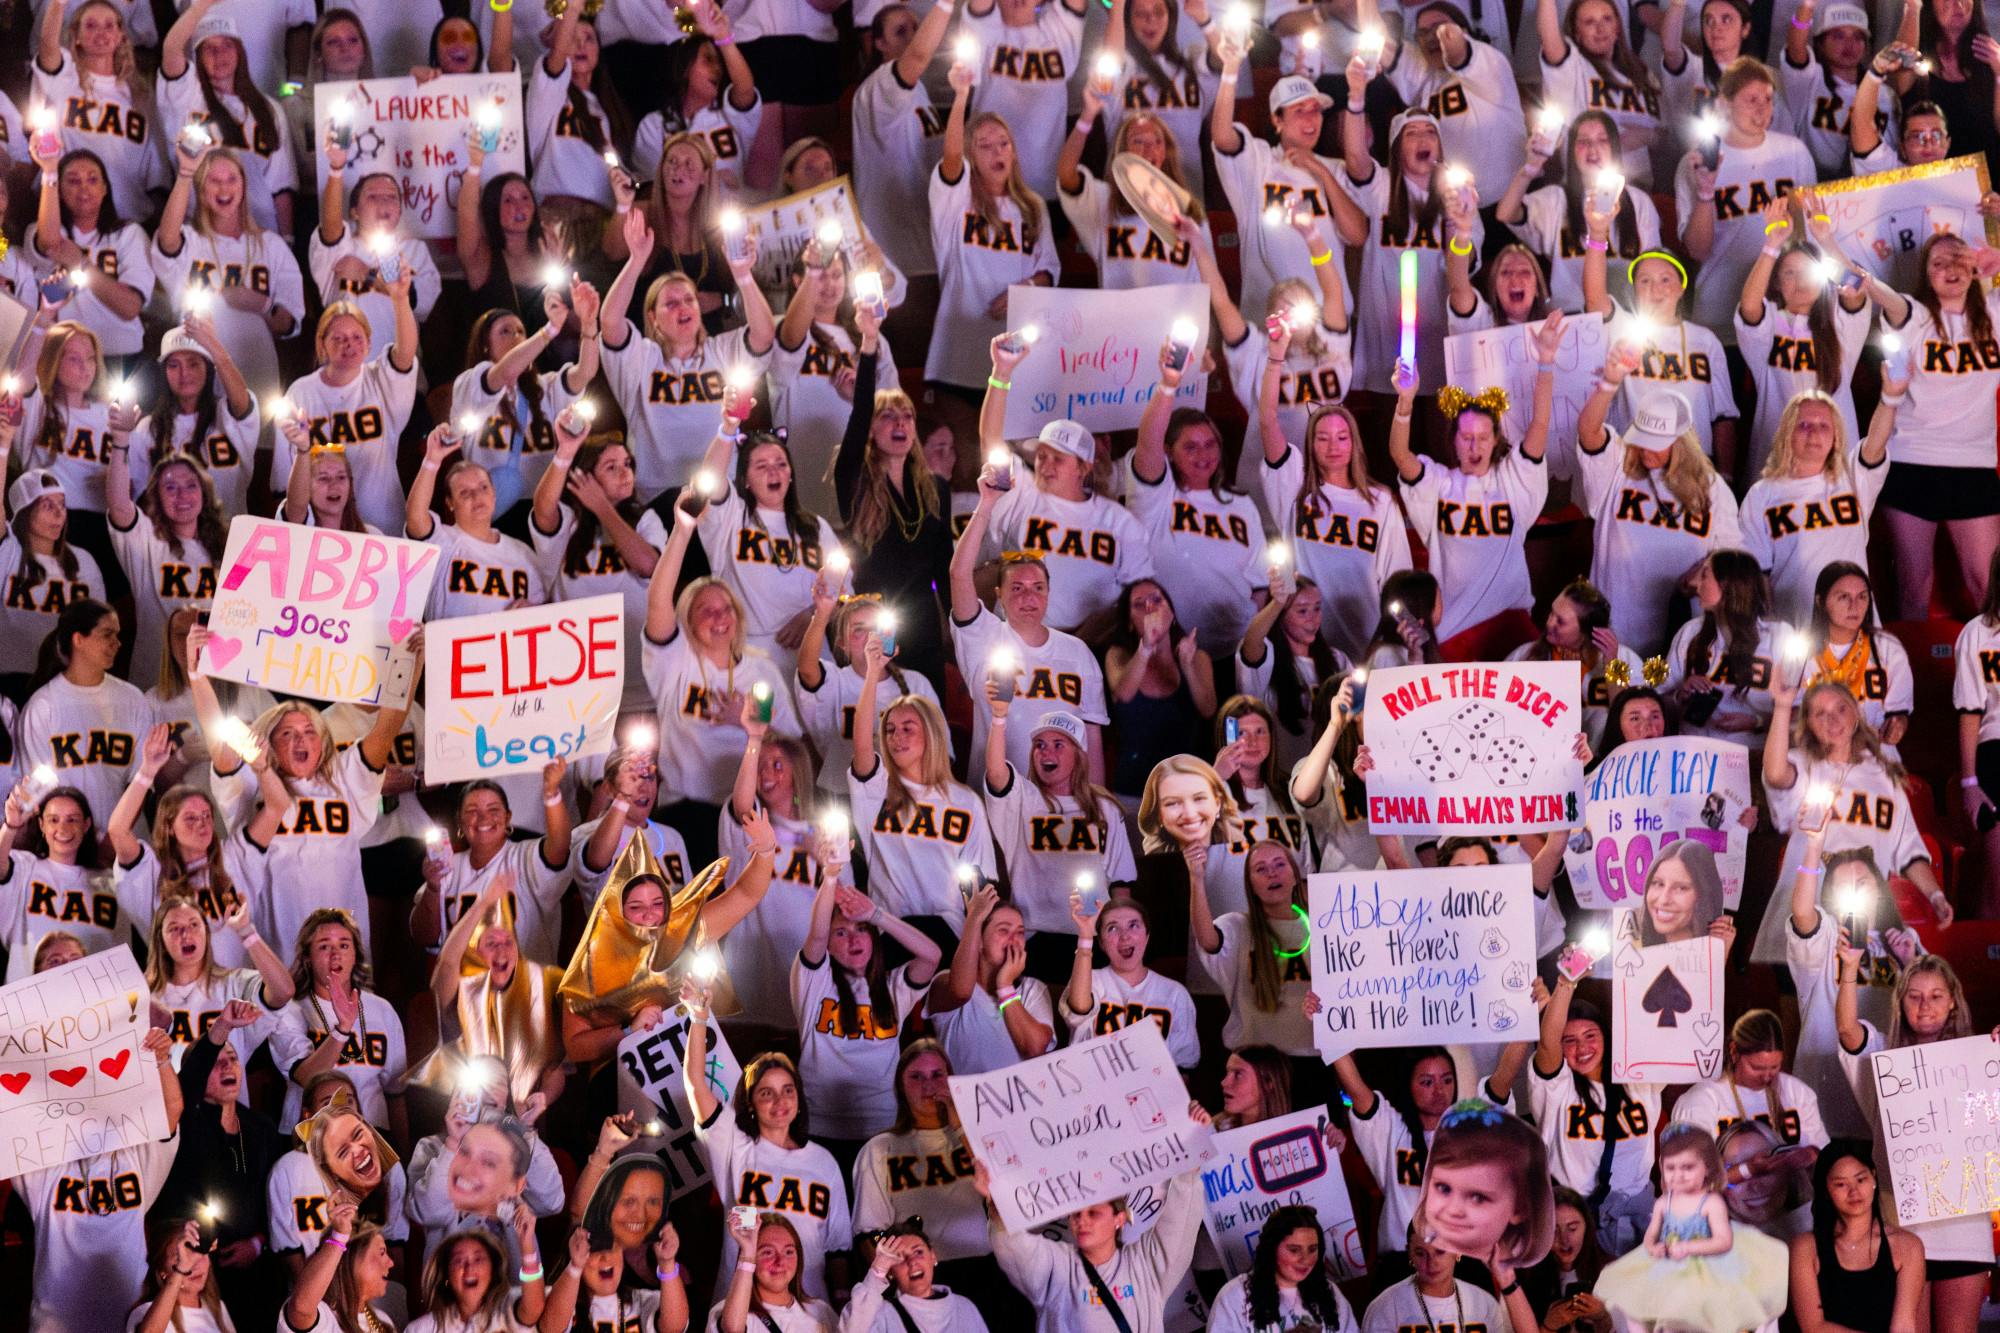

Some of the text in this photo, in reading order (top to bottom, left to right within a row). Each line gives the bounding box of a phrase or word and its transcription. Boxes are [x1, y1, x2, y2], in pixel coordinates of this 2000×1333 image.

[372, 95, 469, 122] LAUREN
[395, 144, 457, 167] is the
[1067, 384, 1125, 420] proud
[1171, 499, 1249, 547] ΚΑΘ
[1438, 500, 1513, 537] ΚΑΘ
[1765, 494, 1861, 540] ΚΑΘ
[1023, 516, 1118, 566] ΚΑΘ
[160, 562, 220, 600] ΚΑ
[222, 523, 437, 617] ABBY
[273, 605, 350, 645] goes
[261, 638, 377, 703] HARD
[452, 617, 619, 699] ELISE
[1014, 667, 1083, 706] ΑΘ
[1381, 668, 1569, 729] ROLL THE DICE
[50, 730, 134, 768] ΚΑΘ
[475, 724, 585, 769] beast
[1670, 752, 1718, 795] RAY
[279, 798, 351, 836] ΑΘ
[1369, 796, 1431, 823] EMMA
[1437, 796, 1514, 825] ALWAYS
[1608, 807, 1663, 832] is the
[1029, 813, 1108, 854] ΚΑ
[29, 880, 118, 930] ΚΑΘ
[1440, 887, 1506, 917] dance
[1325, 935, 1365, 973] like
[1389, 928, 1459, 961] there's
[64, 952, 132, 1005] THE
[1338, 964, 1486, 1005] dumplings
[1327, 994, 1478, 1032] on the line!
[974, 1037, 1141, 1124] AVA IS THE
[1875, 1048, 1970, 1099] Betting
[46, 1101, 86, 1118] GO
[1030, 1104, 1121, 1147] Queen
[1885, 1096, 1953, 1139] best!
[13, 1107, 150, 1167] REAGAN
[1014, 1171, 1097, 1222] GREEK
[1109, 1132, 1190, 1184] SING!!
[1892, 1142, 1944, 1176] gonna
[55, 1172, 143, 1213] ΚΑΘ
[738, 1170, 832, 1221] ΚΑΘ
[1239, 1195, 1281, 1222] than
